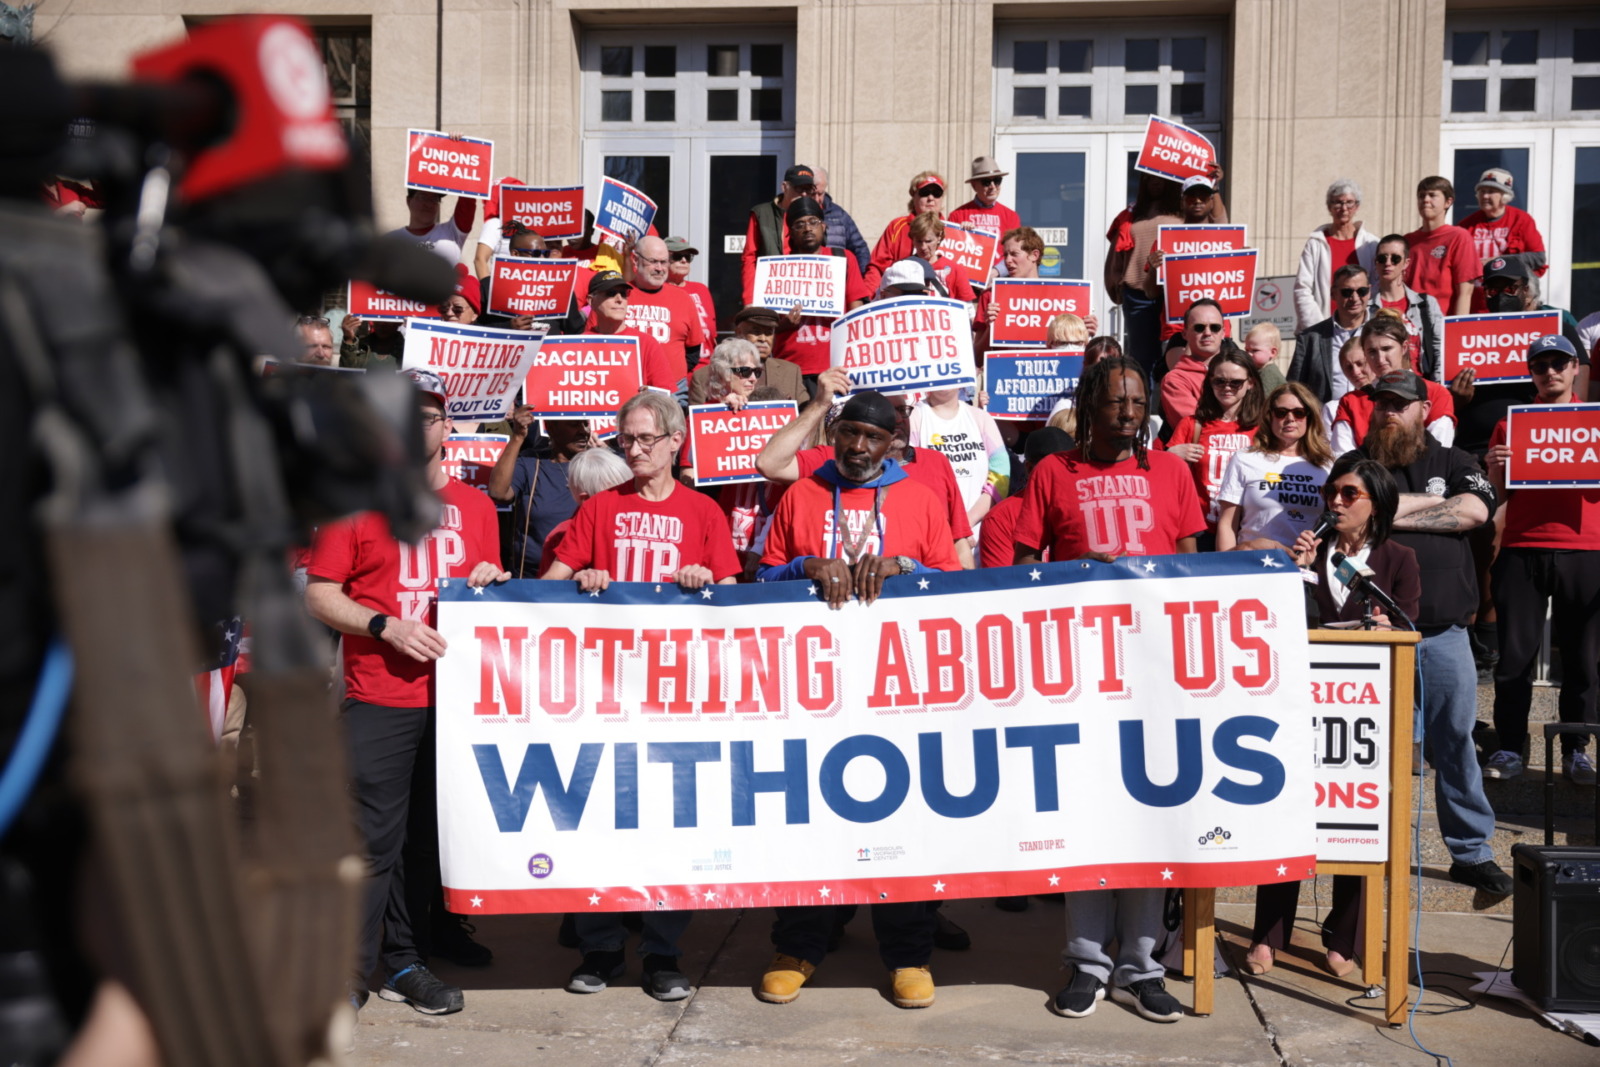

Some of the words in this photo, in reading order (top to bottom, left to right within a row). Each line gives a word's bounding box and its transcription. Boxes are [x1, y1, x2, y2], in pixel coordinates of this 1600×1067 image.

[1159, 134, 1209, 159] UNIONS
[422, 147, 479, 167] UNIONS
[1151, 146, 1181, 165] FOR
[1182, 154, 1209, 172] ALL
[418, 161, 449, 177] FOR
[452, 165, 481, 181] ALL
[514, 201, 572, 213] UNIONS
[622, 191, 647, 212] TRULY
[512, 215, 543, 227] FOR
[546, 214, 574, 226] ALL
[969, 214, 1000, 226] STAND
[1039, 229, 1066, 244] NTER
[1172, 241, 1232, 252] UNIONS
[937, 249, 956, 261] OR
[956, 251, 983, 271] ALL
[500, 266, 571, 281] RACIALLY
[769, 262, 833, 280] NOTHING
[1180, 270, 1245, 286] UNIONS
[517, 284, 554, 297] JUST
[764, 279, 811, 297] ABOUT
[814, 281, 834, 297] US
[1179, 288, 1216, 303] FOR
[1218, 285, 1246, 301] ALL
[367, 298, 426, 312] HIRING
[507, 298, 557, 311] HIRING
[763, 297, 817, 309] WITHOUT
[819, 300, 834, 309] US
[1009, 298, 1077, 312] UNIONS
[625, 304, 671, 322] STAND
[1005, 313, 1042, 327] FOR
[846, 308, 952, 343] NOTHING
[1461, 331, 1542, 347] UNIONS
[428, 337, 524, 369] NOTHING
[533, 350, 632, 366] RACIALLY
[842, 337, 922, 370] ABOUT
[926, 334, 958, 358] US
[1458, 350, 1500, 366] FOR
[848, 364, 932, 387] WITHOUT
[936, 362, 962, 377] US
[1015, 360, 1060, 376] TRULY
[486, 371, 514, 396] US
[558, 370, 609, 387] JUST
[995, 378, 1080, 394] AFFORDABLE
[482, 399, 503, 411] US
[548, 390, 620, 406] HIRING
[1007, 397, 1058, 412] HOUSIN
[700, 414, 792, 434] RACIALLY
[941, 433, 968, 443] STOP
[1208, 434, 1251, 451] STAND
[1530, 427, 1600, 444] UNION
[716, 454, 758, 471] HIRI
[946, 452, 977, 462] NOW!
[1526, 448, 1575, 464] FOR
[441, 465, 479, 480] UST
[1278, 472, 1314, 484] STOP
[1075, 475, 1151, 500] STAND
[1279, 492, 1320, 508] NOW!
[615, 511, 683, 543] STAND
[1079, 498, 1154, 555] UP
[614, 538, 681, 583] UP
[474, 625, 843, 724] NOTHING
[867, 603, 1142, 716] ABOUT
[1164, 598, 1280, 699] US
[471, 722, 1081, 833] WITHOUT
[1118, 715, 1286, 808] US
[1019, 840, 1043, 852] STAND
[1044, 840, 1053, 850] UP
[1054, 839, 1065, 849] KC
[1327, 836, 1379, 845] #FIGHTFOR15
